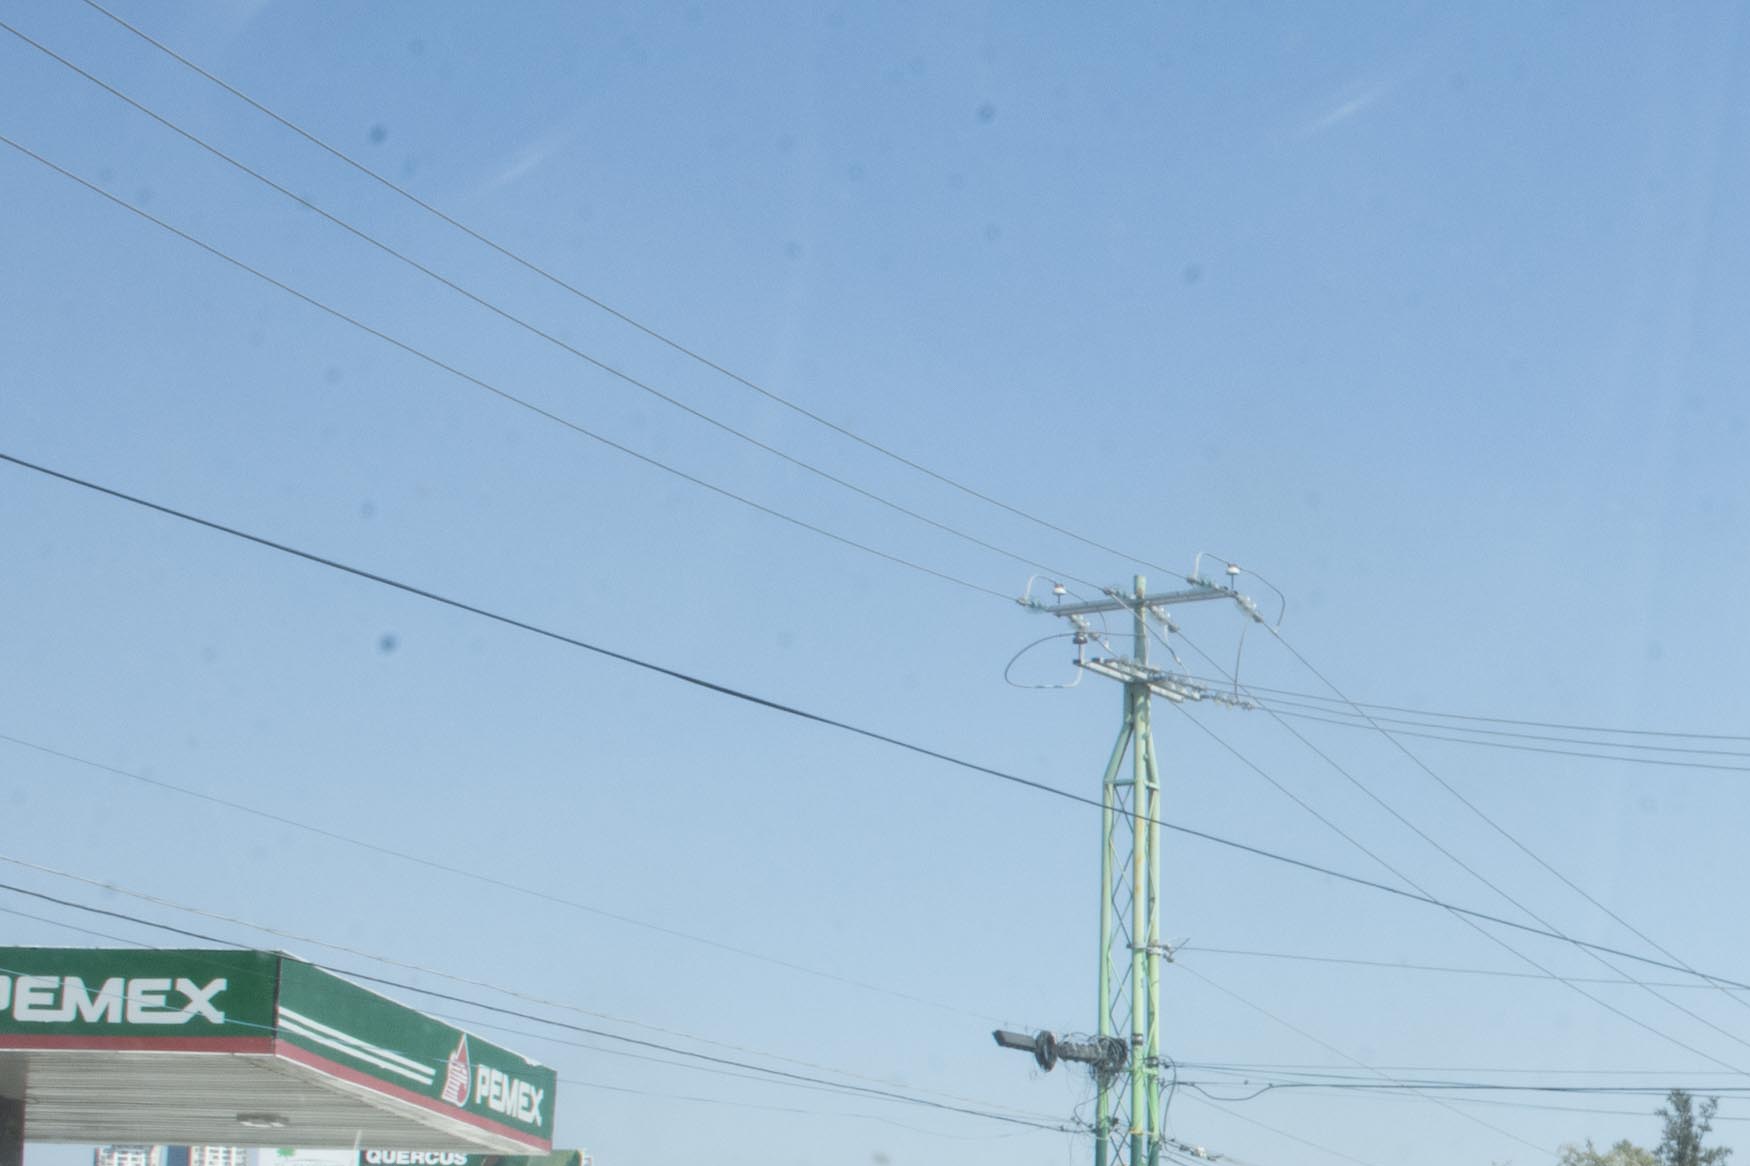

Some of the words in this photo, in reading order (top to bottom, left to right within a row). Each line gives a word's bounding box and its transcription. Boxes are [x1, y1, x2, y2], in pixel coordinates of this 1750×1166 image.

[0, 975, 227, 1024] EMEX
[475, 1064, 544, 1127] PEMEX
[366, 1151, 468, 1166] QUERCUS
